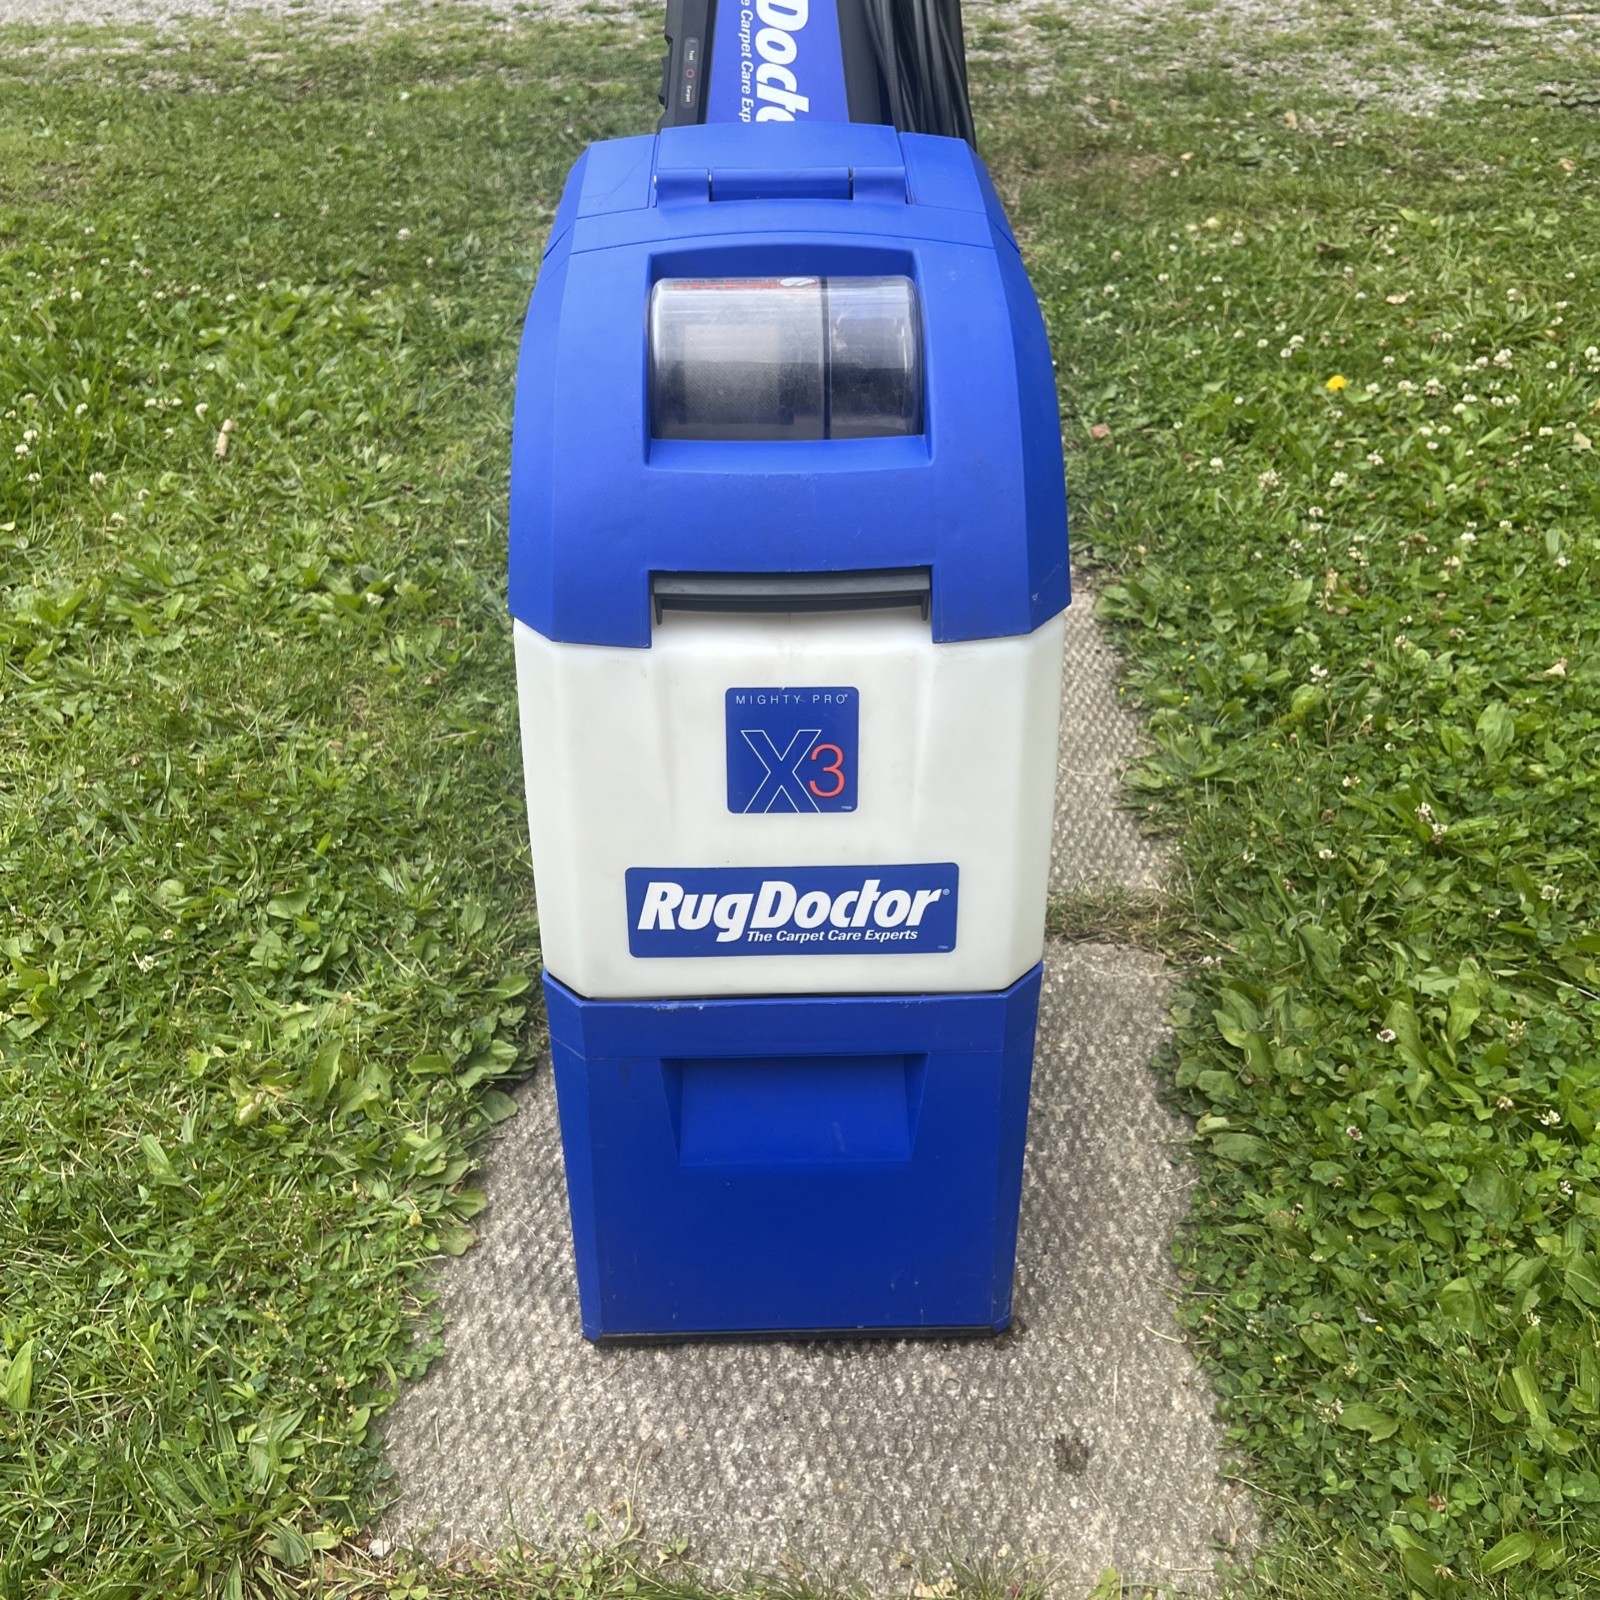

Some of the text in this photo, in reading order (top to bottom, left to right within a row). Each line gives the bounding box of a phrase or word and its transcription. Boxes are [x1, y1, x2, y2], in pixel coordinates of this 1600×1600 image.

[738, 9, 754, 58] Carpet
[740, 60, 754, 94] Care
[736, 695, 801, 705] MIGHTY
[740, 729, 846, 814] X3
[747, 929, 918, 943] The Carpet Care Experts
